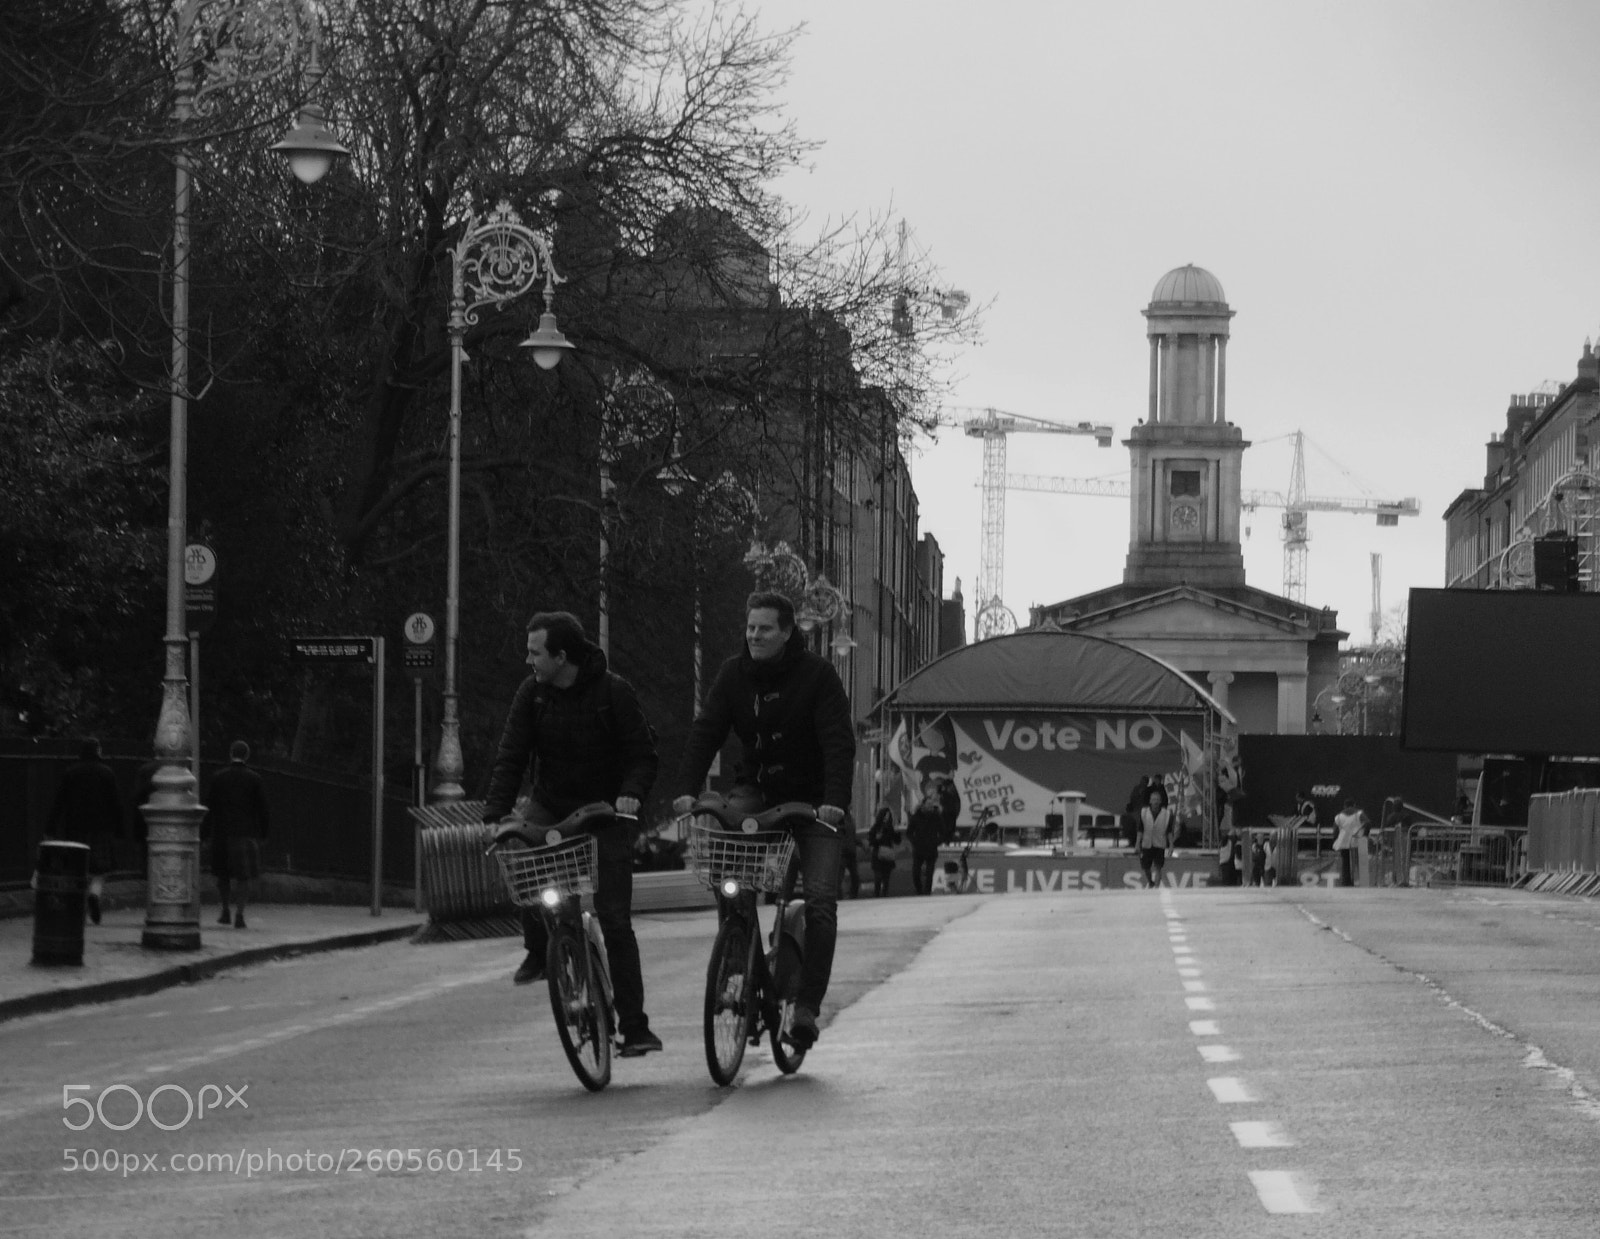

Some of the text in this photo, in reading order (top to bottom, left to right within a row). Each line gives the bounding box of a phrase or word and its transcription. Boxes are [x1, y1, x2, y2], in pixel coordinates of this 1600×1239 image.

[982, 718, 1163, 750] Vote NO
[963, 773, 1001, 789] Keep
[963, 784, 1015, 803] Them
[969, 796, 1025, 820] Safe
